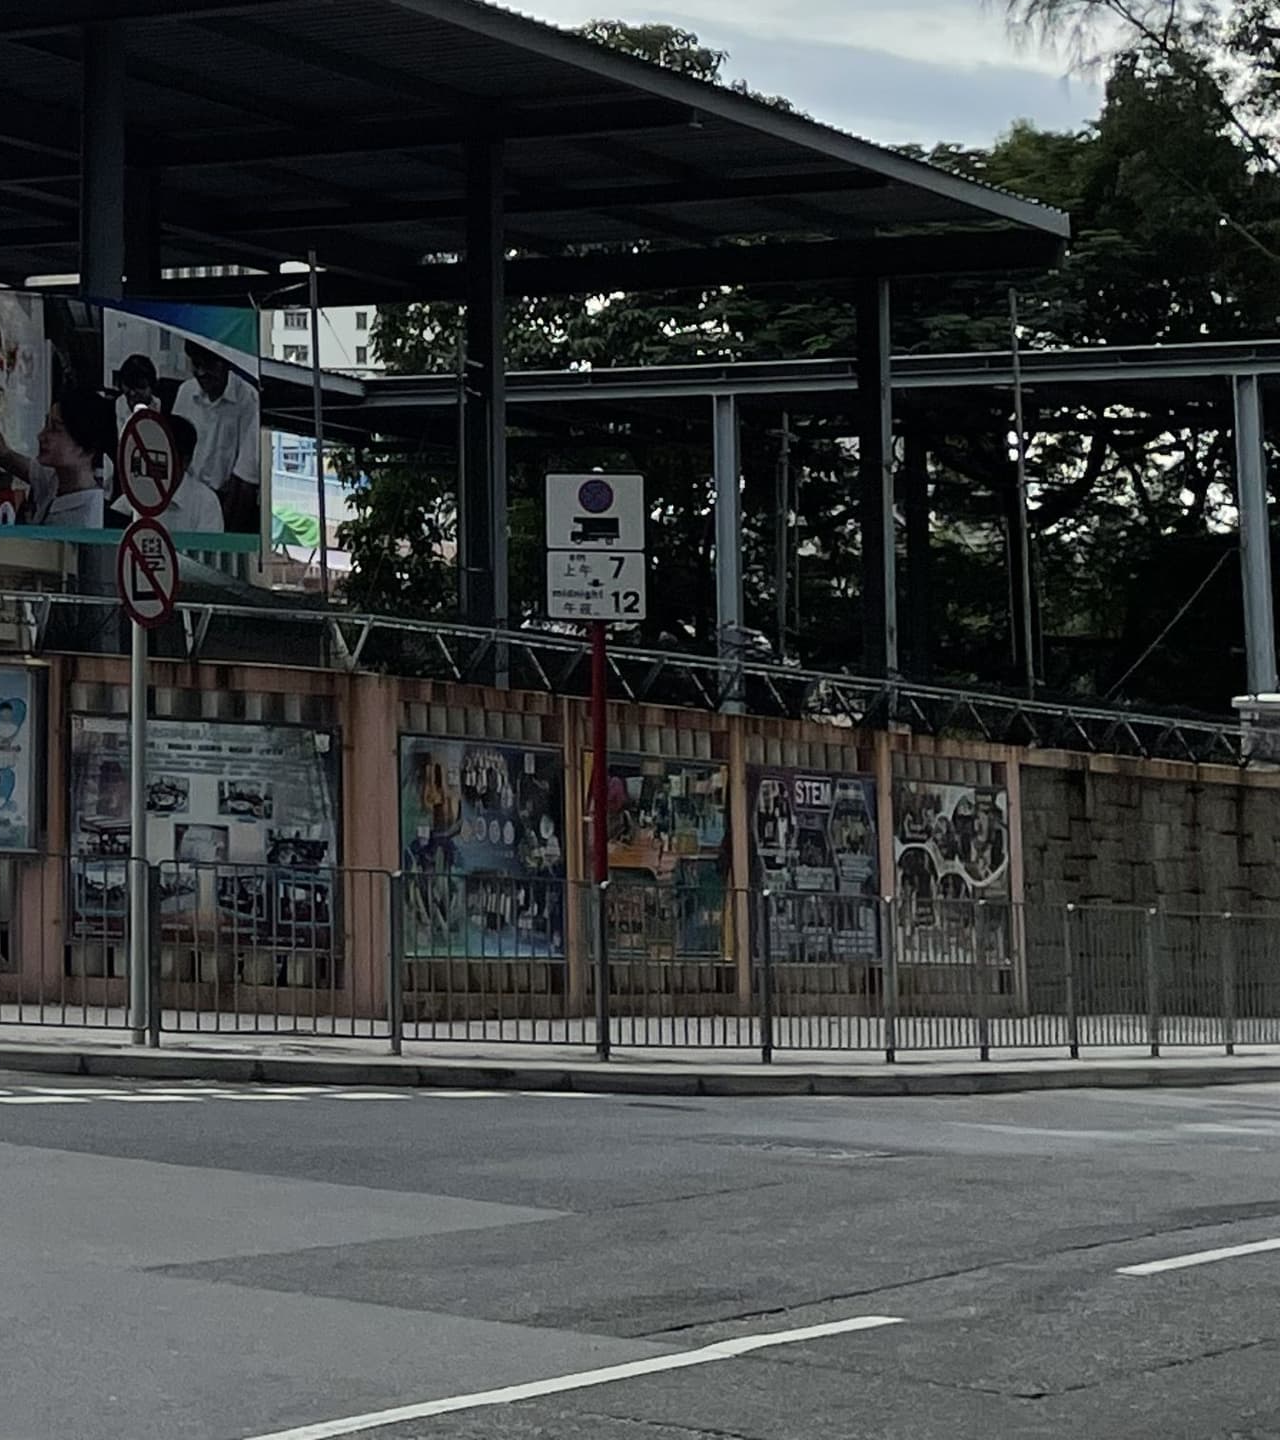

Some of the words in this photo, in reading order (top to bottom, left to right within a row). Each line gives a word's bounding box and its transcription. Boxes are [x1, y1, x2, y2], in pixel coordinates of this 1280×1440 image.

[563, 563, 593, 577] 上午
[609, 556, 625, 579] 7
[552, 589, 604, 600] midnight
[611, 590, 640, 614] 12
[795, 779, 832, 806] STEM
